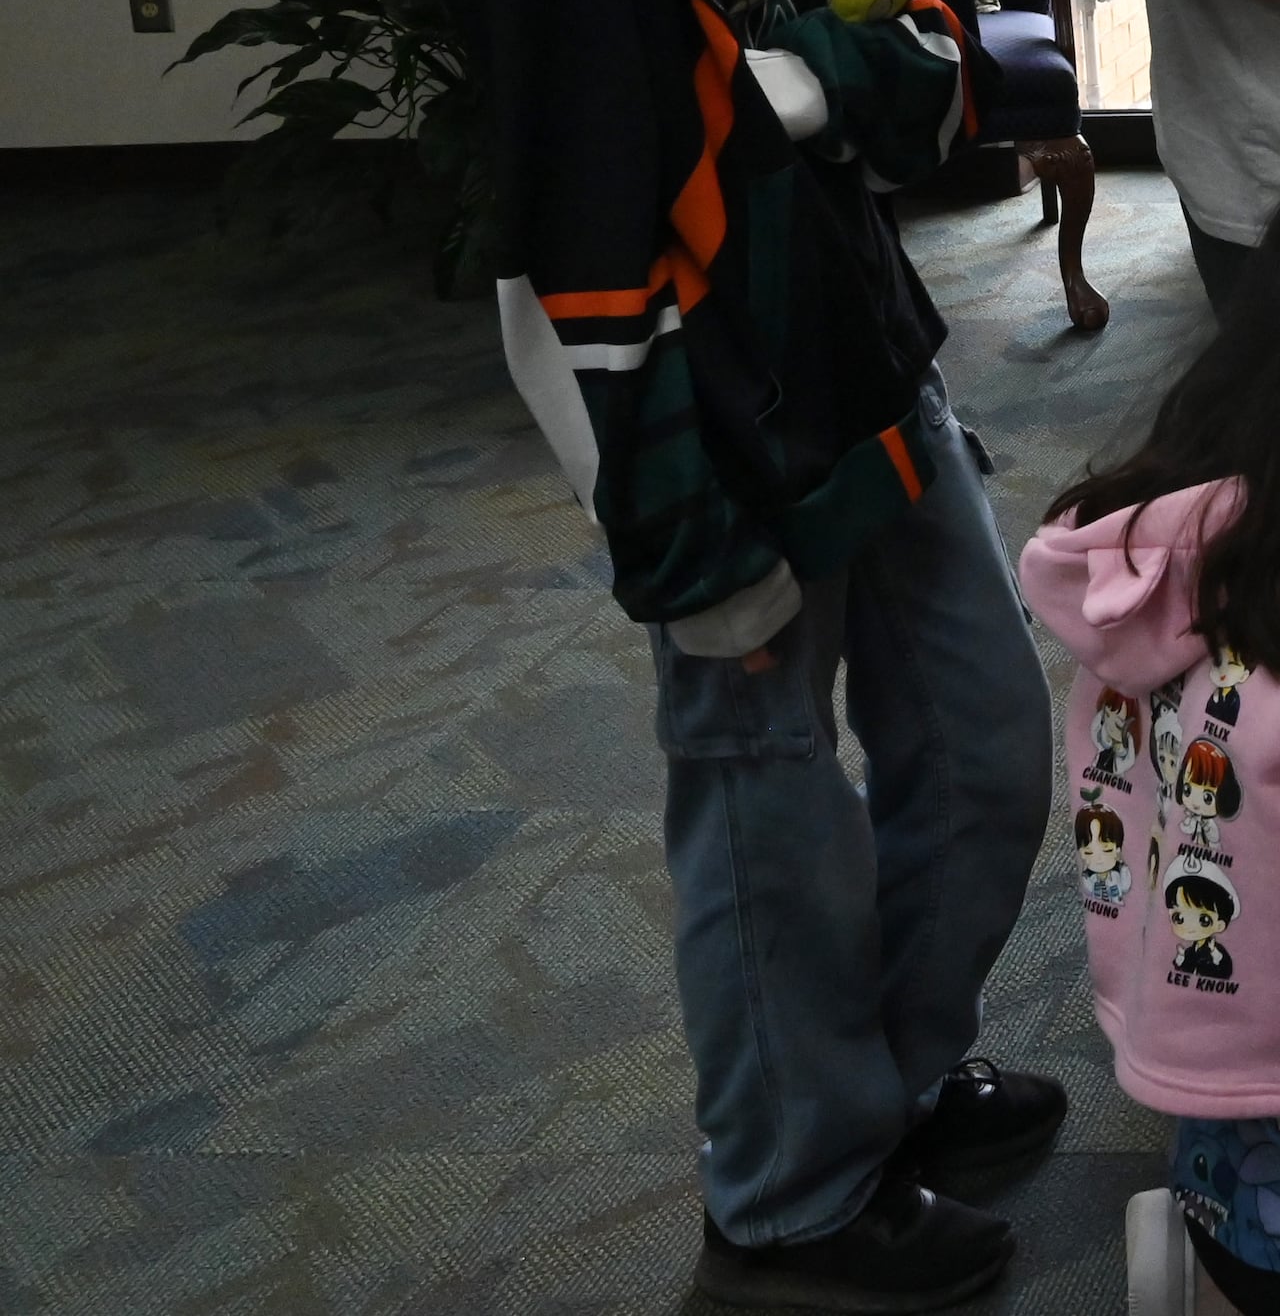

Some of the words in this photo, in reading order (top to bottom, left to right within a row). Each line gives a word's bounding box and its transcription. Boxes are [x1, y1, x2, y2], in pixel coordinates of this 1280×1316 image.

[1203, 719, 1231, 743] FELIX
[1081, 765, 1134, 796] CHANGBIN
[1177, 842, 1233, 868] HYUNJIN
[1166, 970, 1191, 988] LEE
[1195, 975, 1240, 996] KNOW
